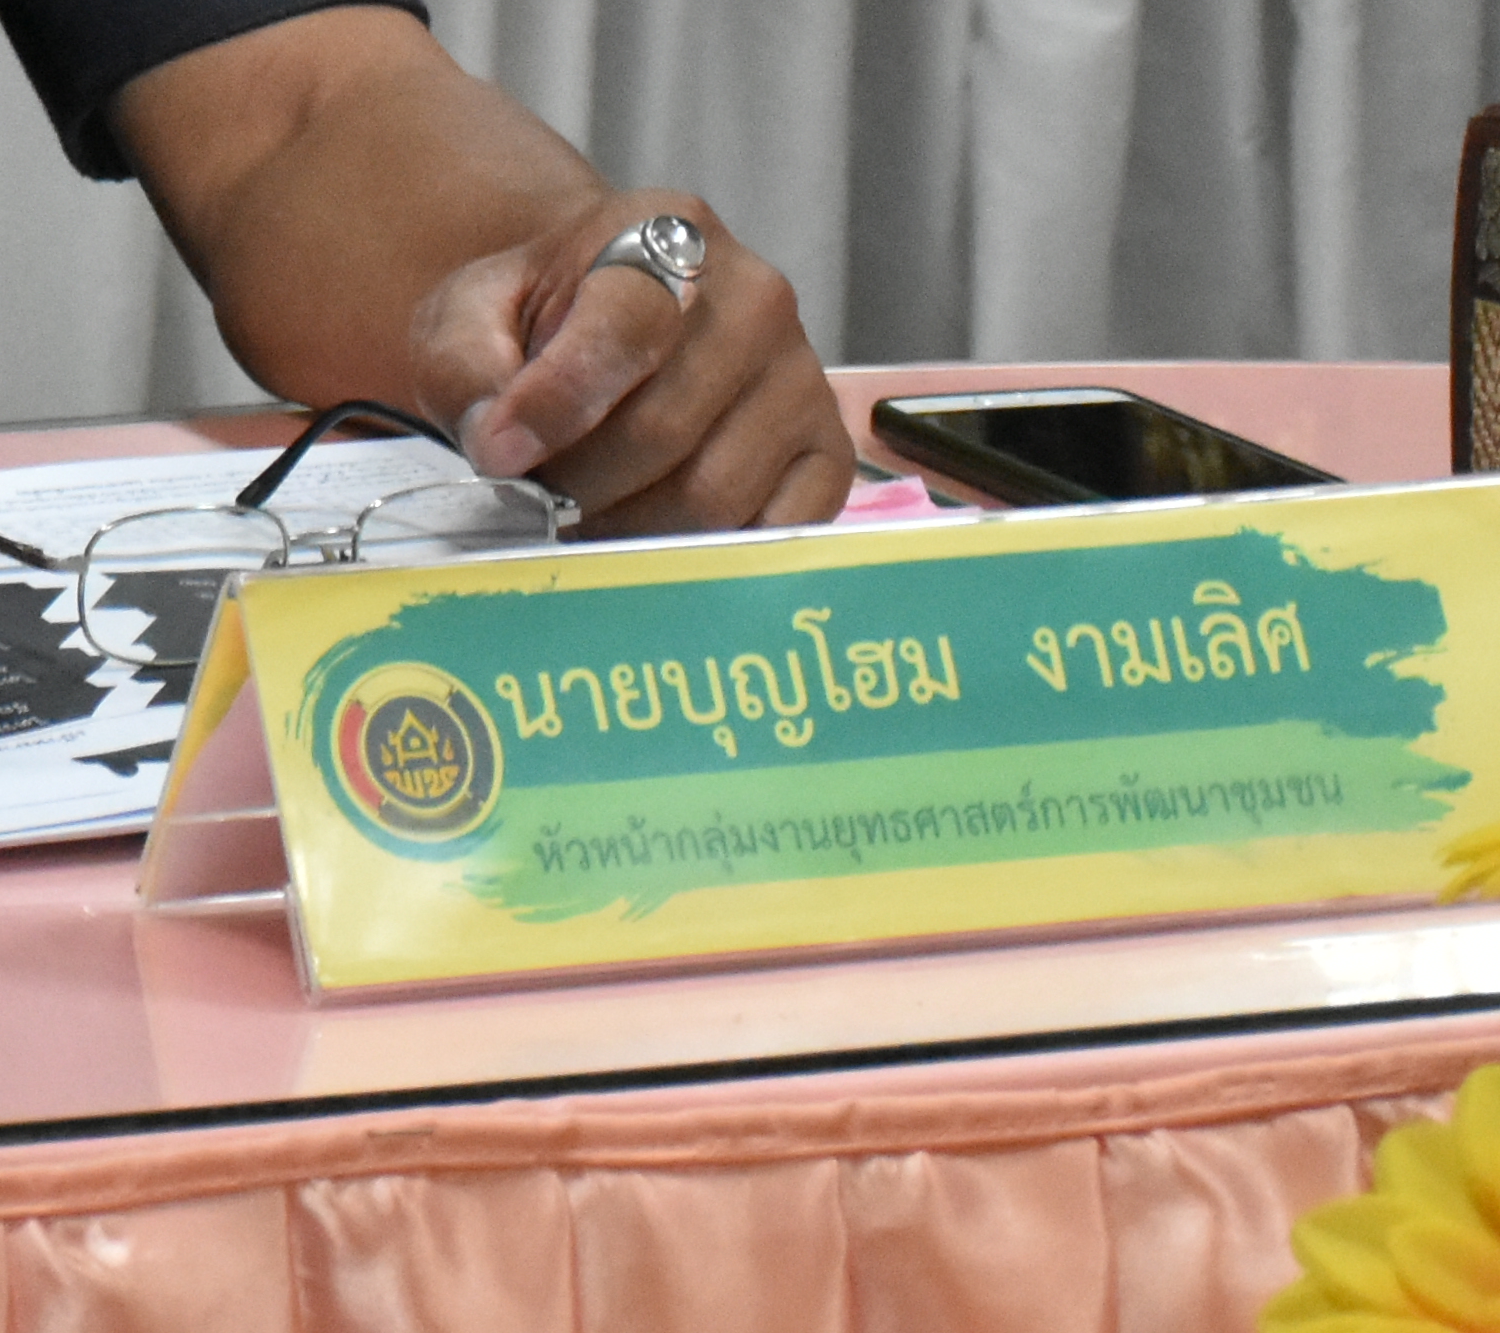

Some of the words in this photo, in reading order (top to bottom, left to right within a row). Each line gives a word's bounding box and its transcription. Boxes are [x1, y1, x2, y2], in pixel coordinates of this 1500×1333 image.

[494, 607, 962, 759] นายบุญโฮม
[1025, 579, 1314, 694] งามเลิศ
[533, 767, 1345, 875] หัวหน้ากลุ่มงานยุทธศาสตร์การพัฒนาชุมชน
